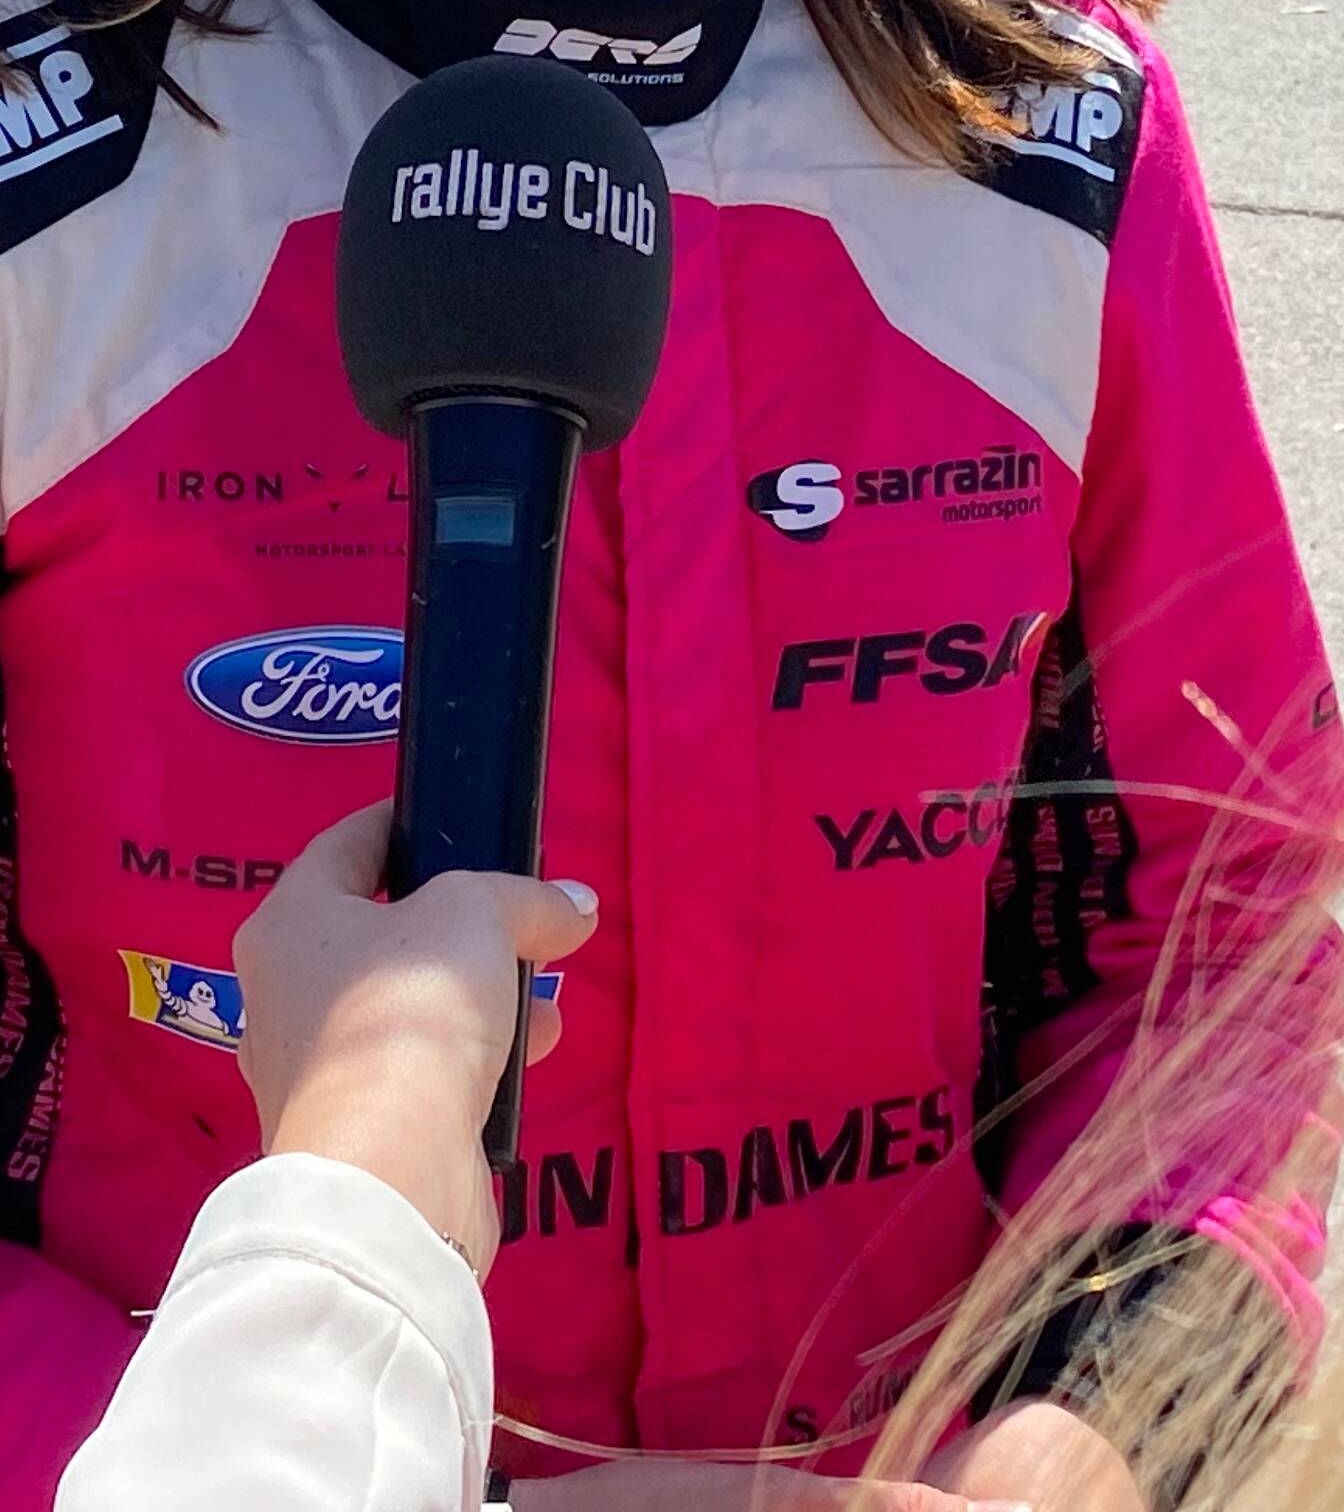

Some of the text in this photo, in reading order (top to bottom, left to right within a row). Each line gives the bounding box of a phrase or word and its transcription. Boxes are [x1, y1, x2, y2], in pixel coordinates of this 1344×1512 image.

[1019, 83, 1123, 153] MP
[392, 148, 656, 257] rallye Club
[158, 471, 284, 502] IRON
[853, 444, 1043, 506] sarrazin
[942, 494, 1043, 525] motorsport
[255, 544, 406, 558] MOTORSPORT LA
[771, 612, 1048, 711] FFSA
[121, 839, 286, 891] M-SP
[8, 1048, 60, 1182] AMES
[659, 1086, 955, 1238] DAMES
